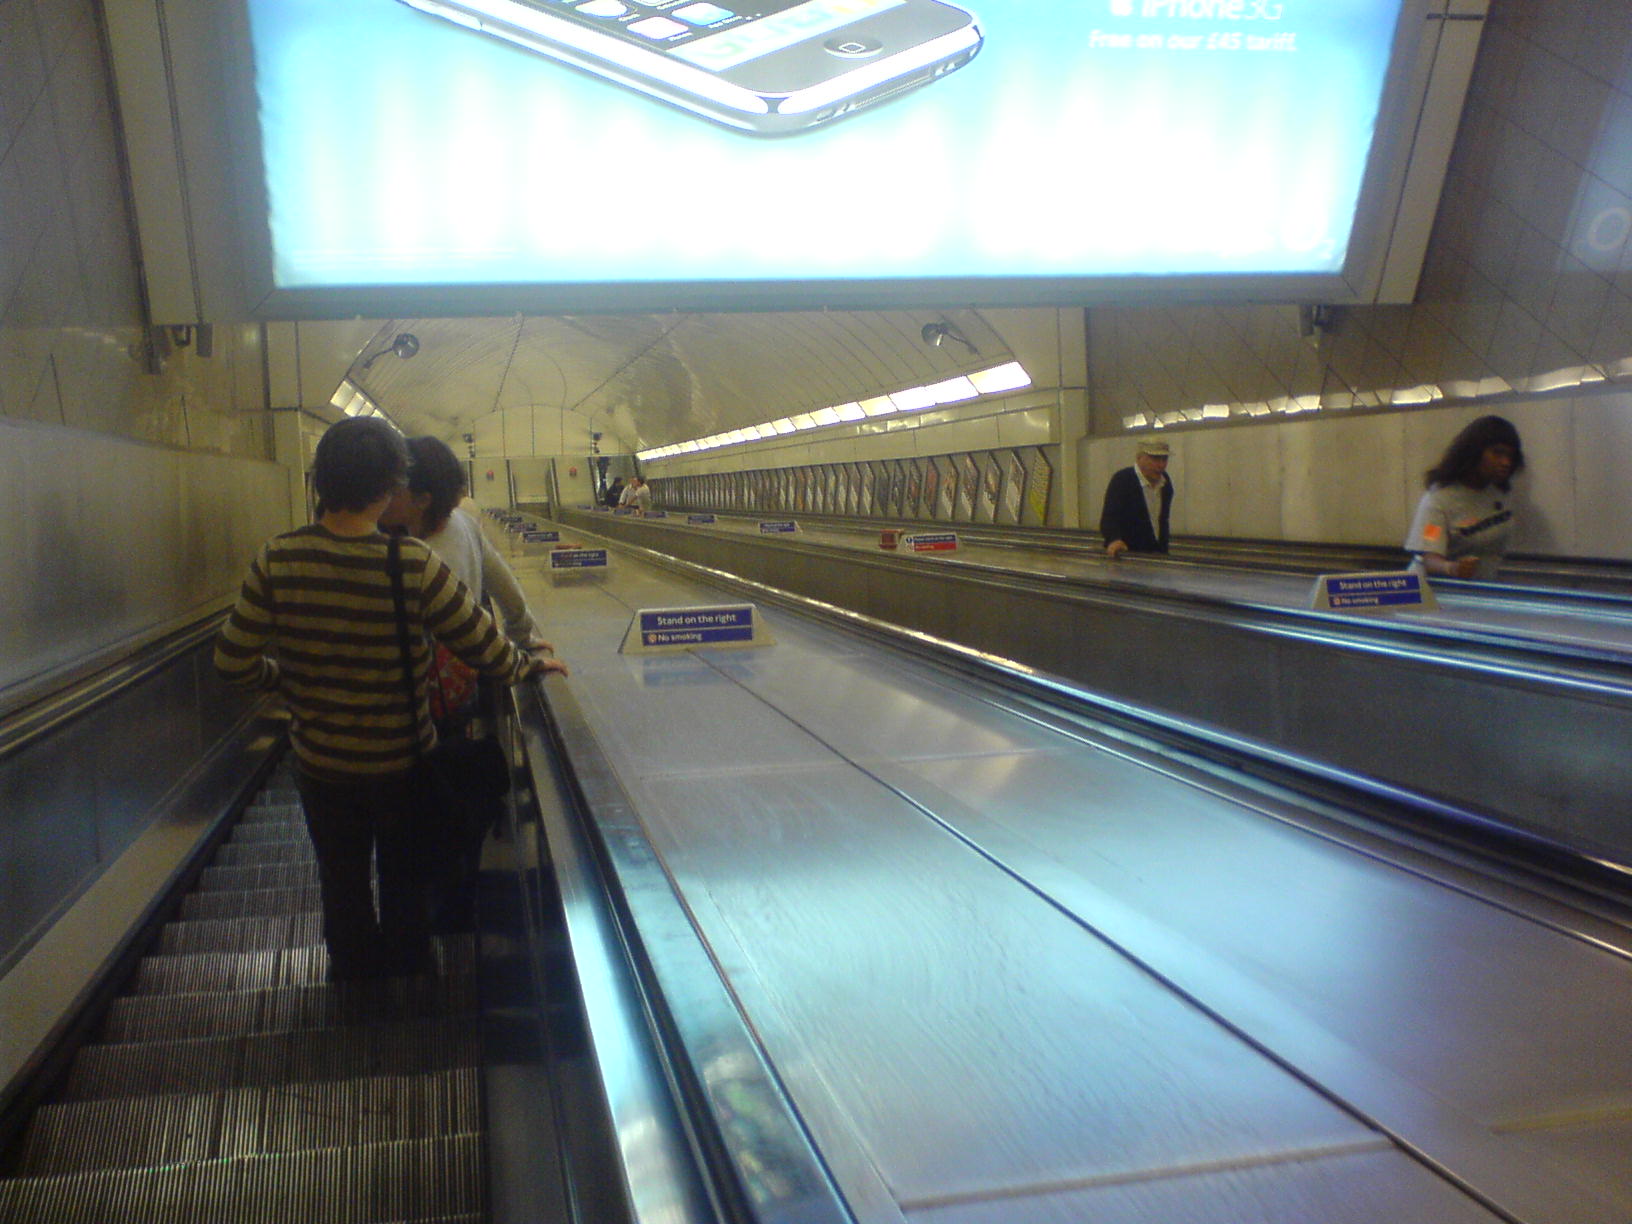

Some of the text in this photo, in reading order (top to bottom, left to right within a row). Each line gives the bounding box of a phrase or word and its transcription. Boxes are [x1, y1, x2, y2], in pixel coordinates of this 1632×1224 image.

[1136, 34, 1164, 49] on
[1167, 34, 1204, 50] our
[657, 613, 737, 626] Stand on the right
[657, 632, 703, 643] No smoking
